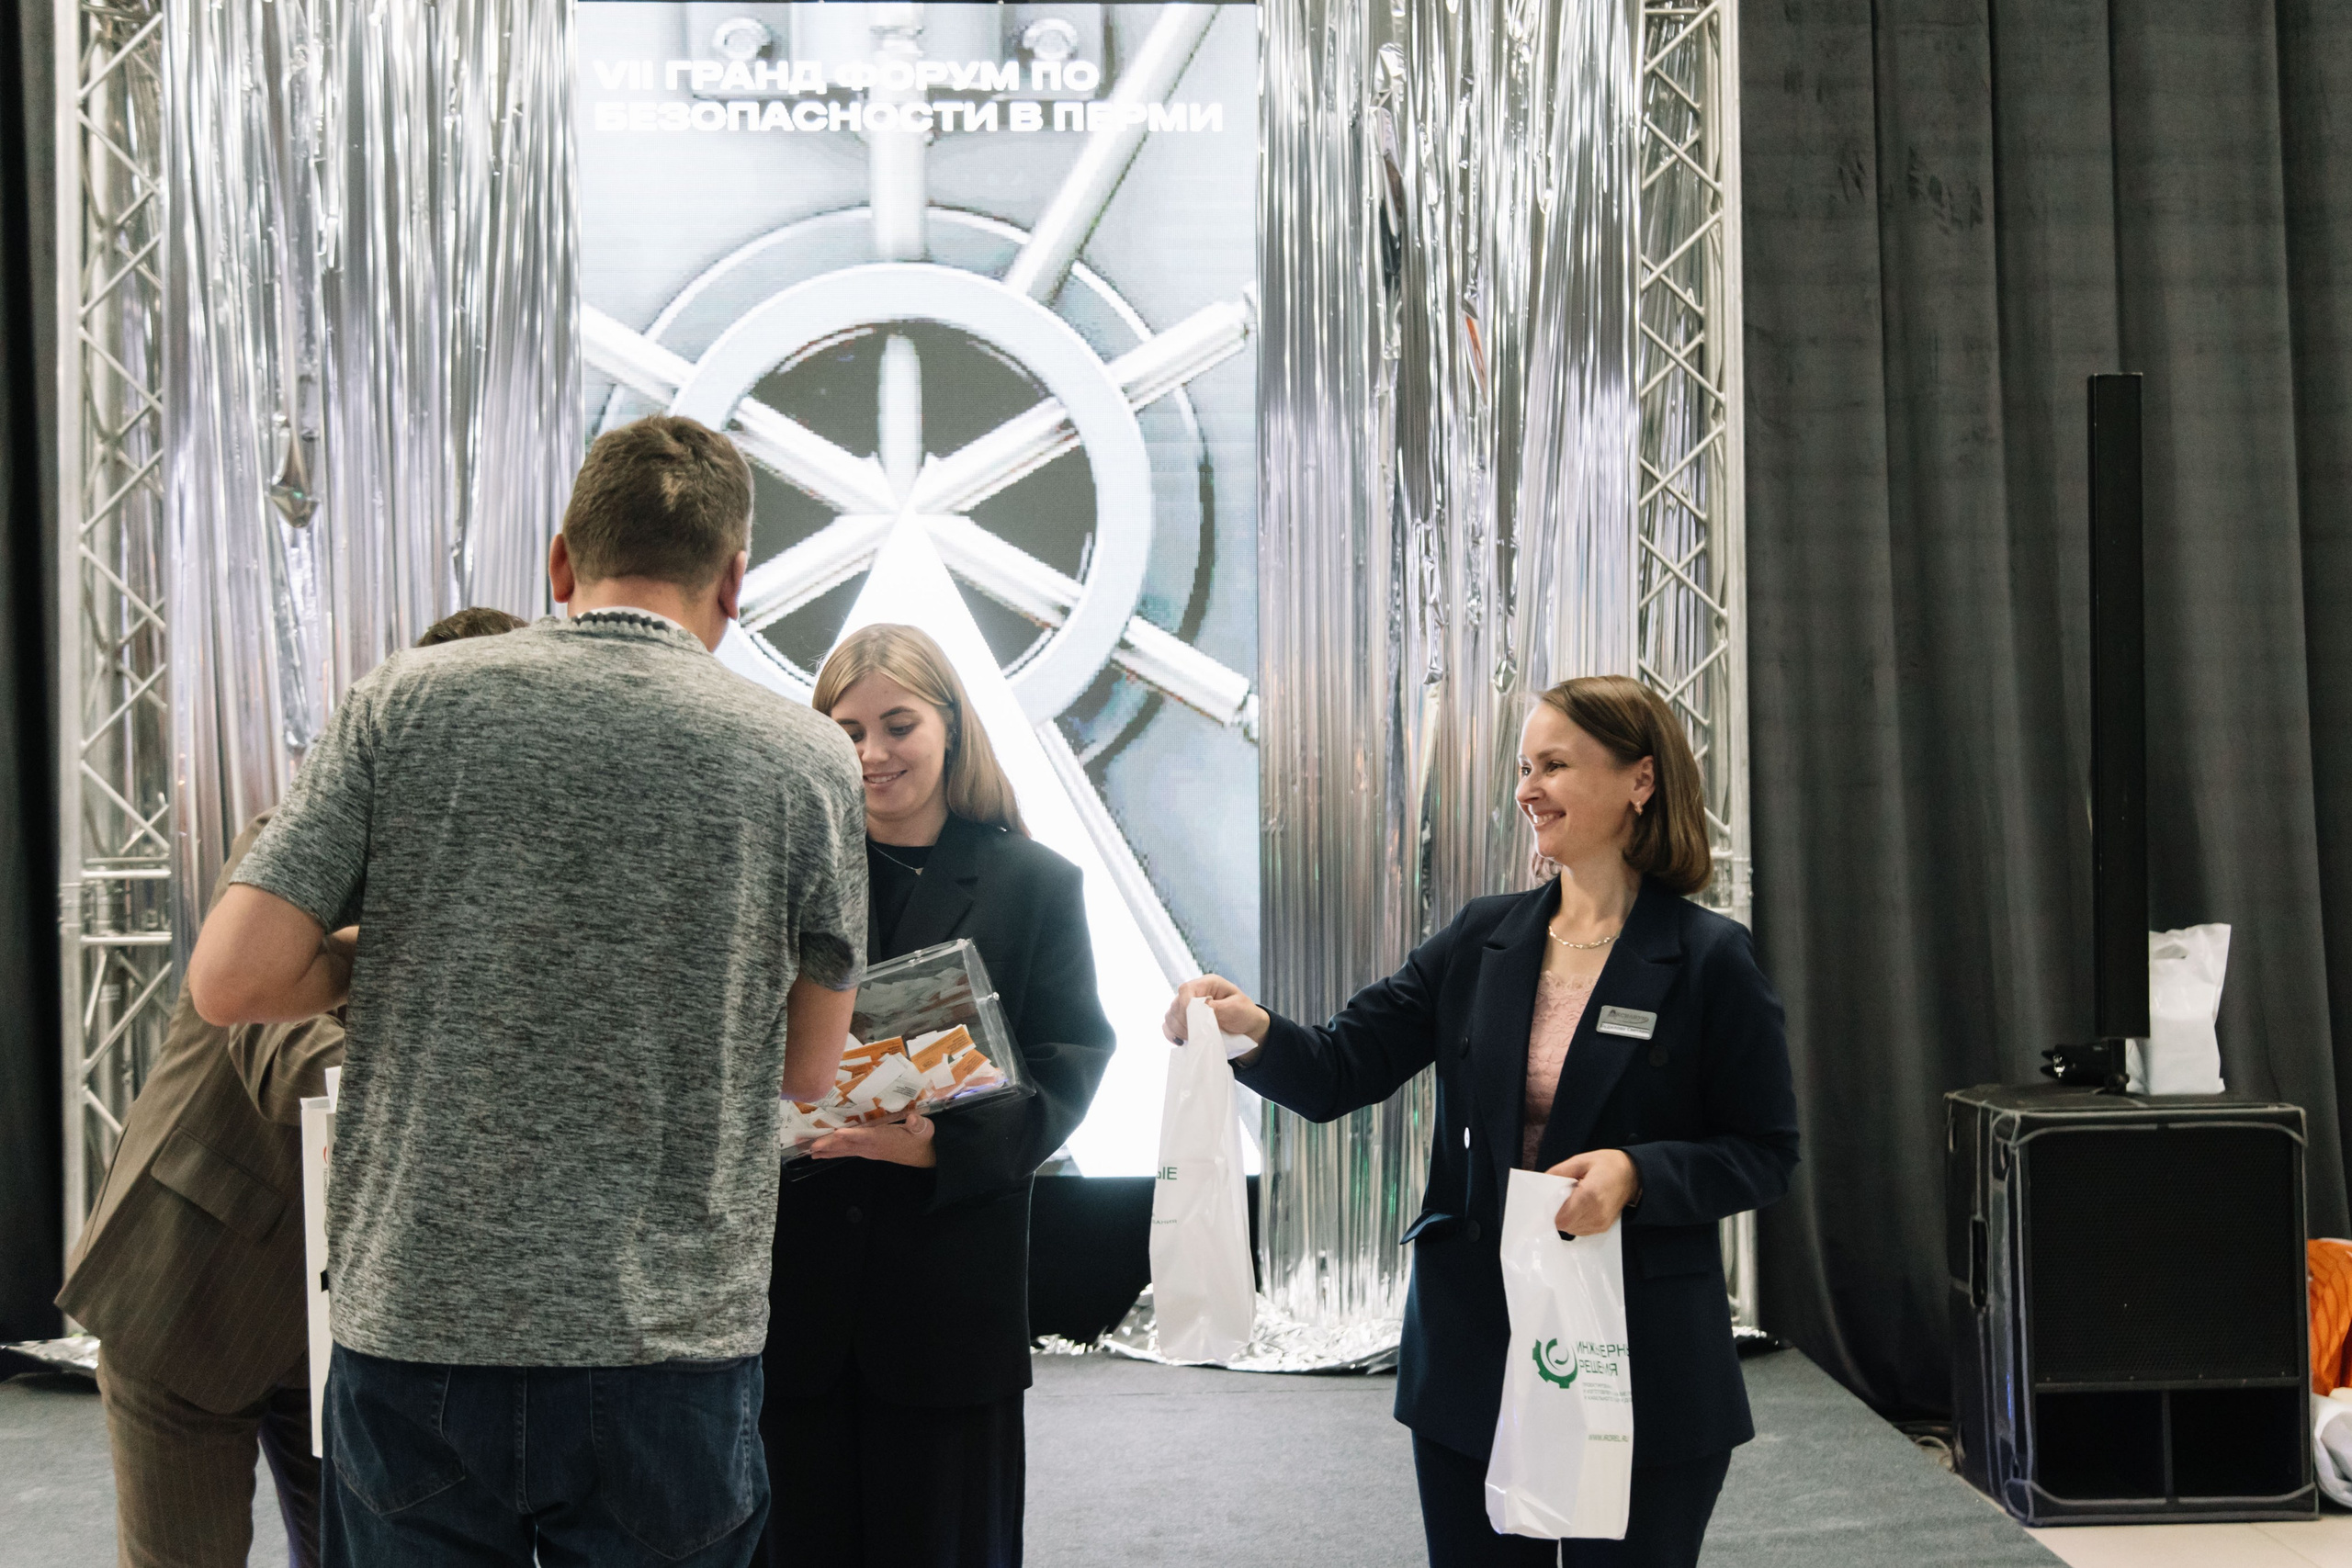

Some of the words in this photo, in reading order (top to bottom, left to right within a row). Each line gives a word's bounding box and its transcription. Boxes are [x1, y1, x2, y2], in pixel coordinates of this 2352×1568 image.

[593, 60, 653, 90] VII
[665, 60, 828, 95] ГРАНД
[833, 60, 1020, 91] ФОРУМ
[1031, 60, 1100, 91] ПО
[594, 101, 998, 131] БЕЗОПАСНОСТИ
[1010, 101, 1044, 131] В
[1054, 101, 1223, 132] ПЕРМИ
